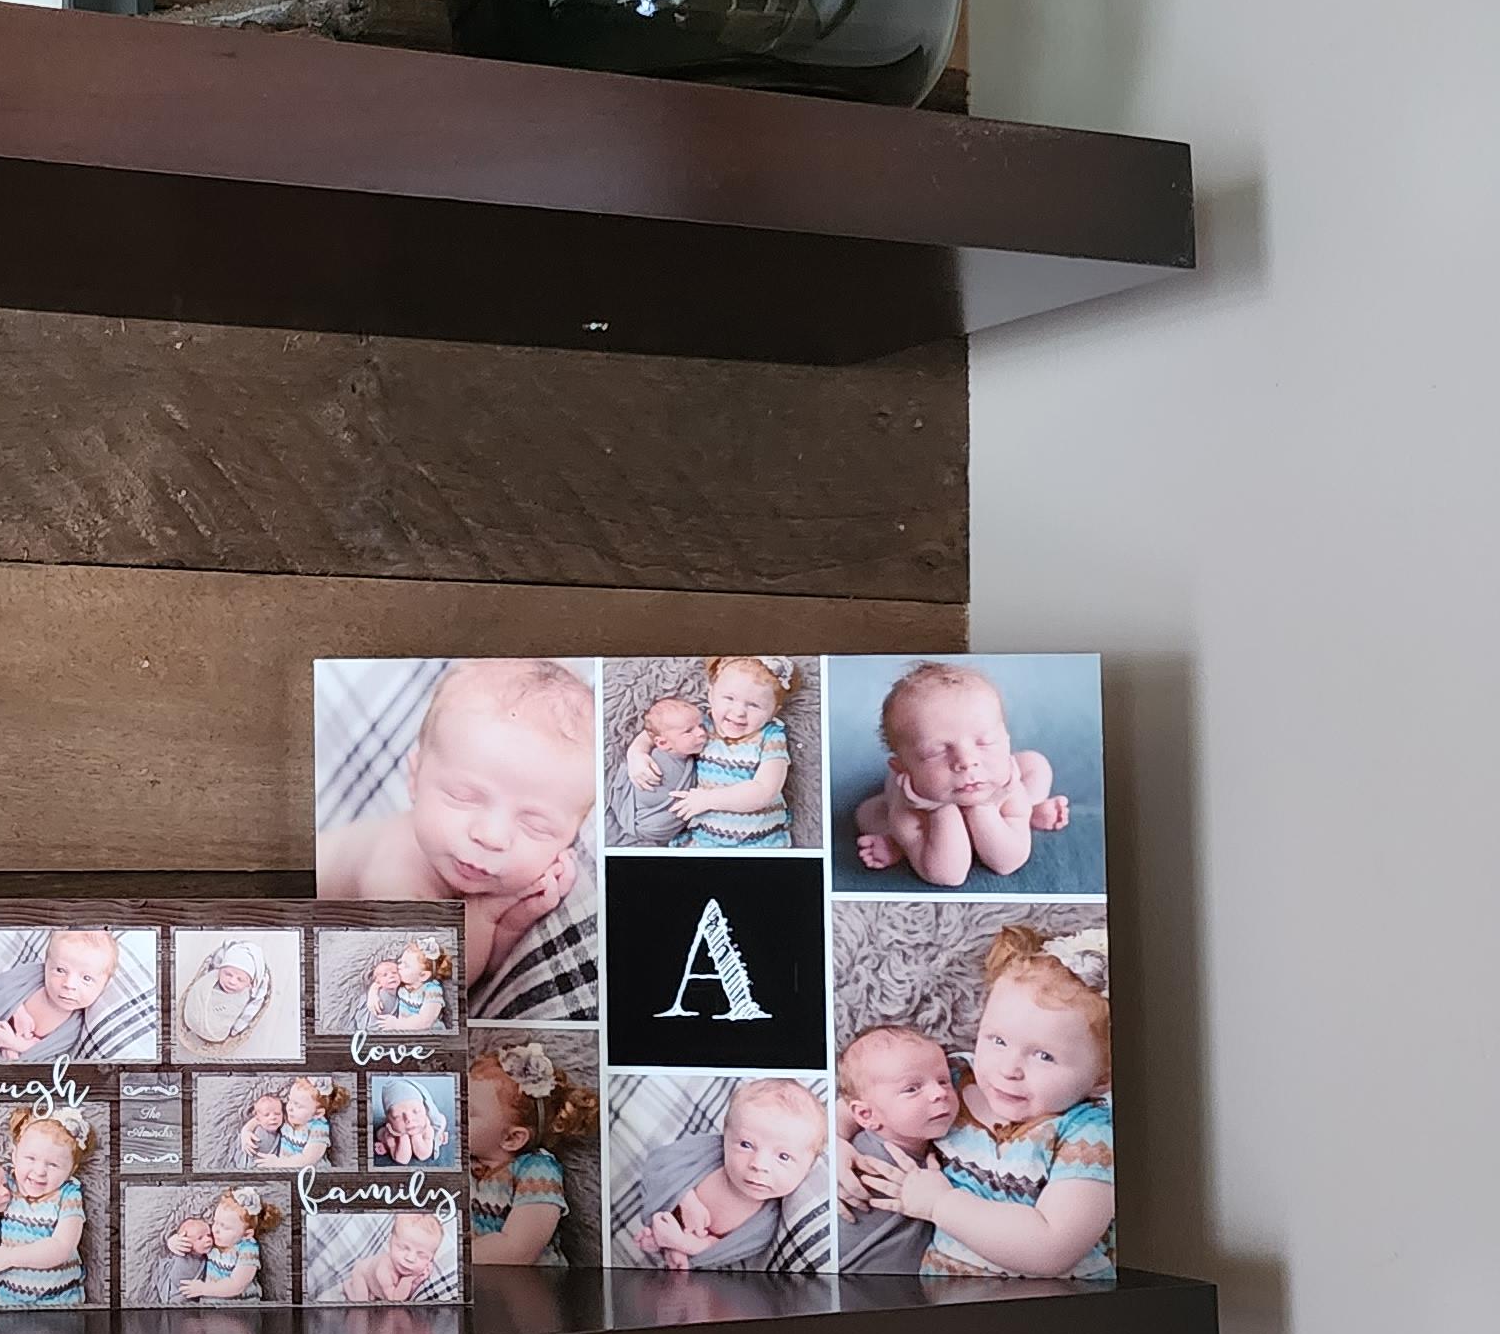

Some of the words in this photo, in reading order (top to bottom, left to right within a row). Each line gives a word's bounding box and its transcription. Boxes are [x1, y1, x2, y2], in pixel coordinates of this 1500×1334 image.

[653, 897, 773, 1022] A
[351, 1029, 435, 1066] love
[297, 1164, 460, 1220] family
